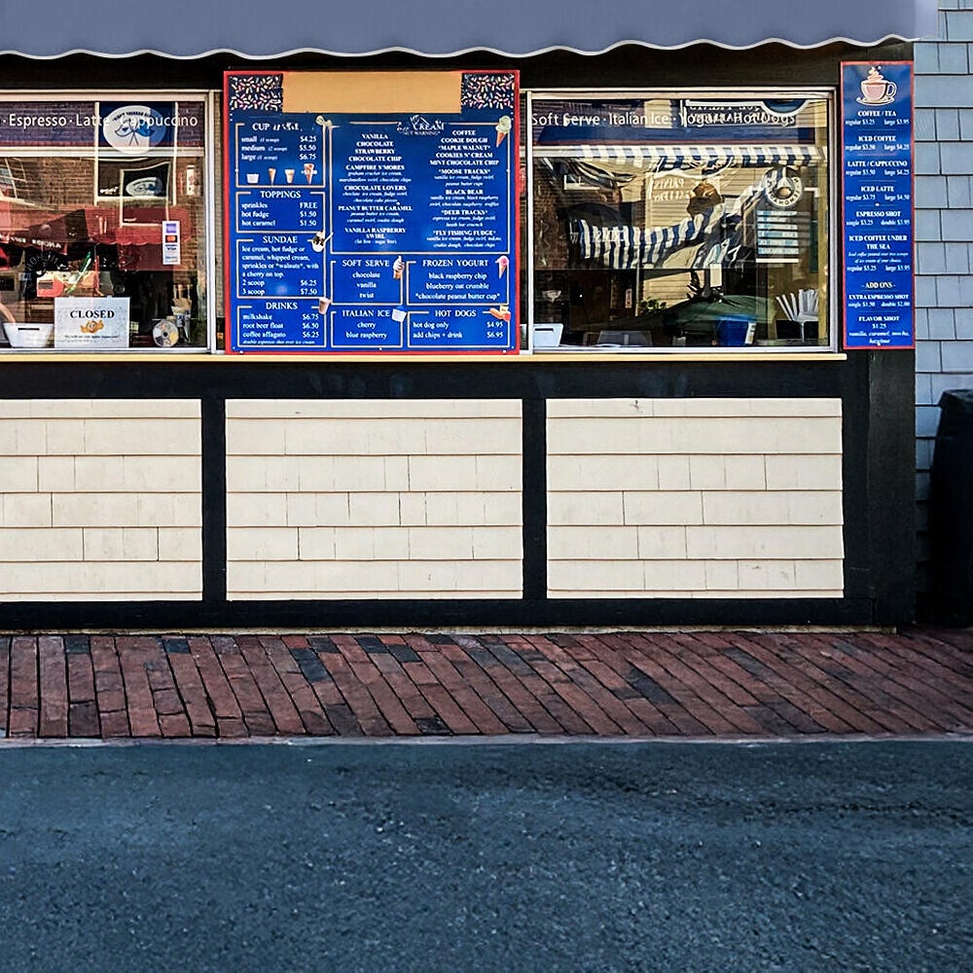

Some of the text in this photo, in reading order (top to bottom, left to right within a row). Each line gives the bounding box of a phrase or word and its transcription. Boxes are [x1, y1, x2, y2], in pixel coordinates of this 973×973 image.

[9, 113, 67, 129] Espresso
[76, 114, 110, 127] Latte
[531, 113, 559, 126] Soft
[563, 113, 600, 126] Serve
[609, 112, 647, 125] Italian
[651, 112, 668, 125] Ice
[252, 122, 270, 131] CUP
[260, 190, 302, 198] TOPPINGS
[252, 211, 270, 219] fudge
[262, 236, 298, 244] SUNDAE
[265, 302, 298, 310] DRINKS
[70, 310, 115, 318] CLOSED
